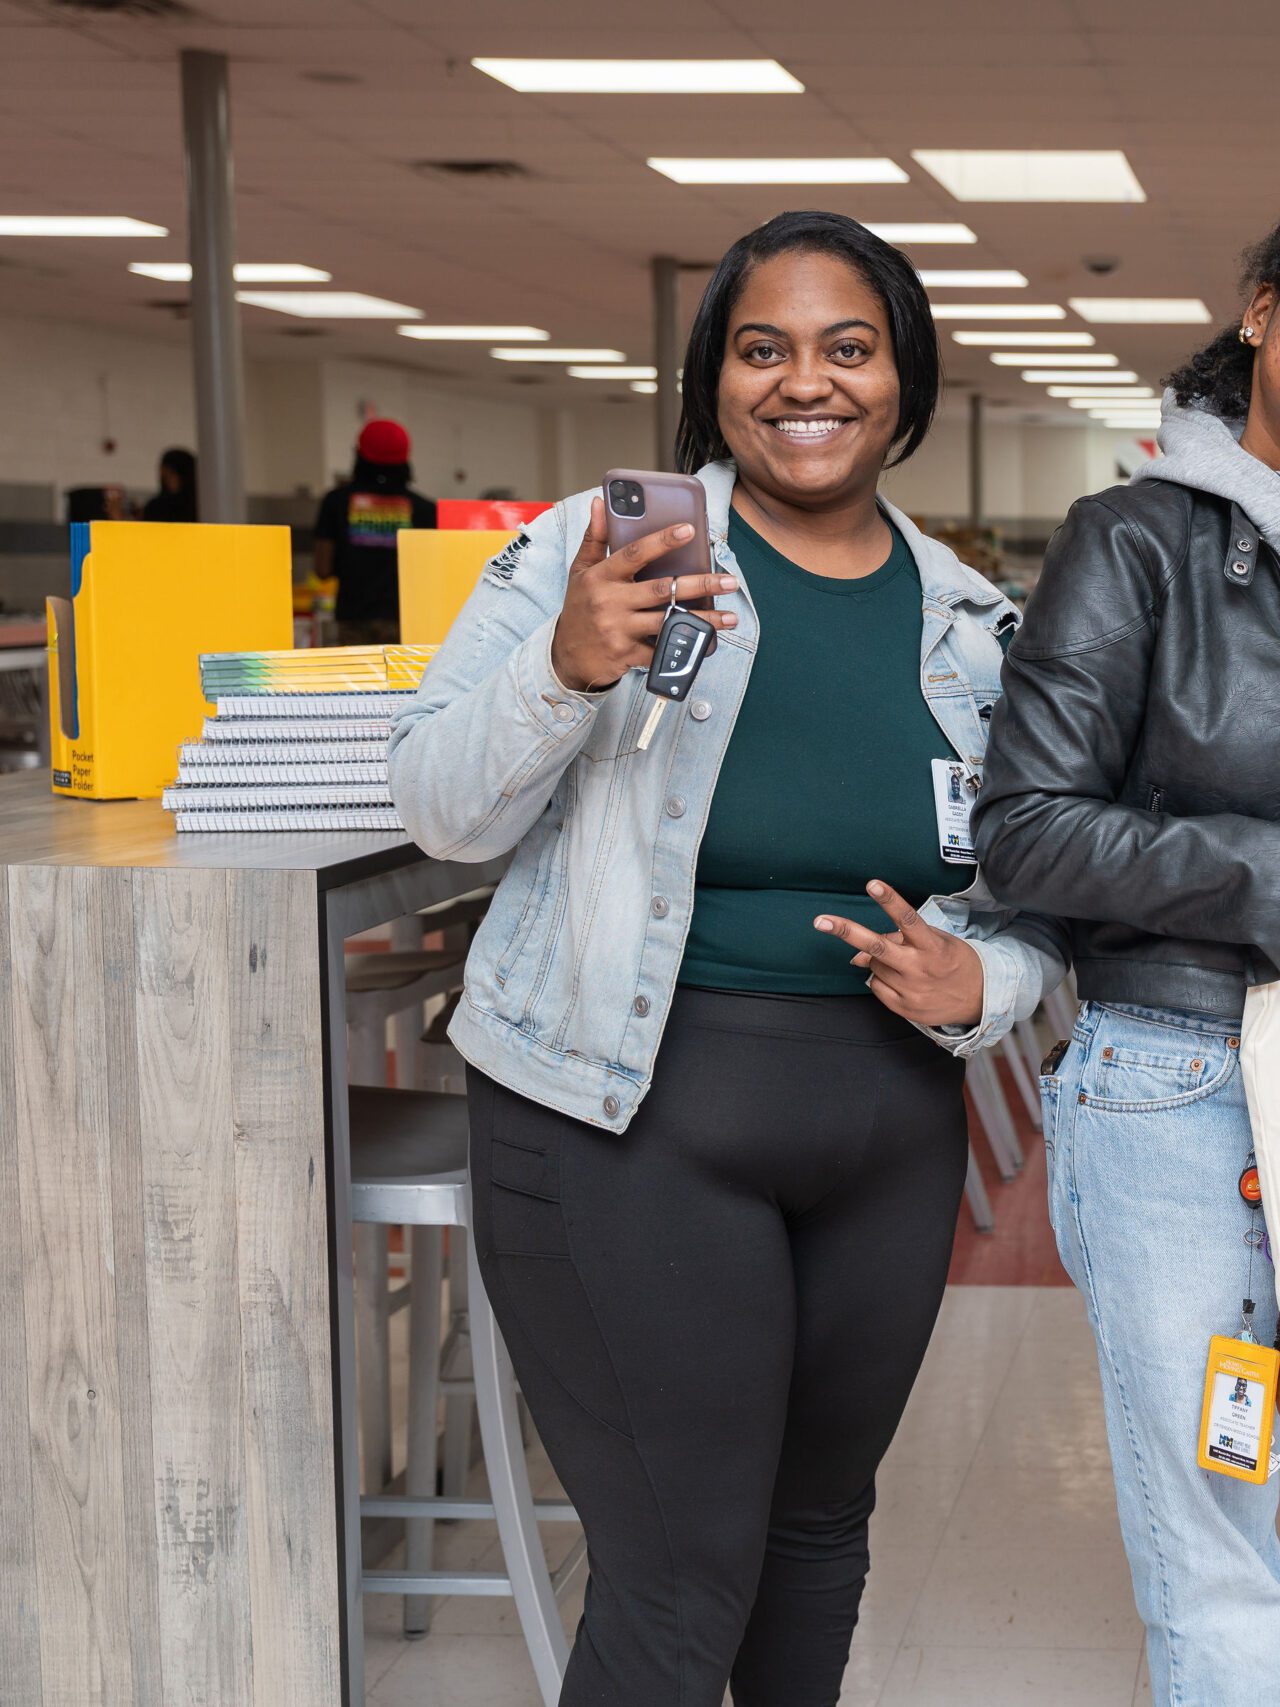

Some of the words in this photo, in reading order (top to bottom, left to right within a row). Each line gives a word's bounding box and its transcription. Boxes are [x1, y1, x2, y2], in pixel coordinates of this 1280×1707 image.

[72, 750, 94, 763] Pocket
[73, 764, 91, 777] Paper
[73, 778, 94, 791] Folder
